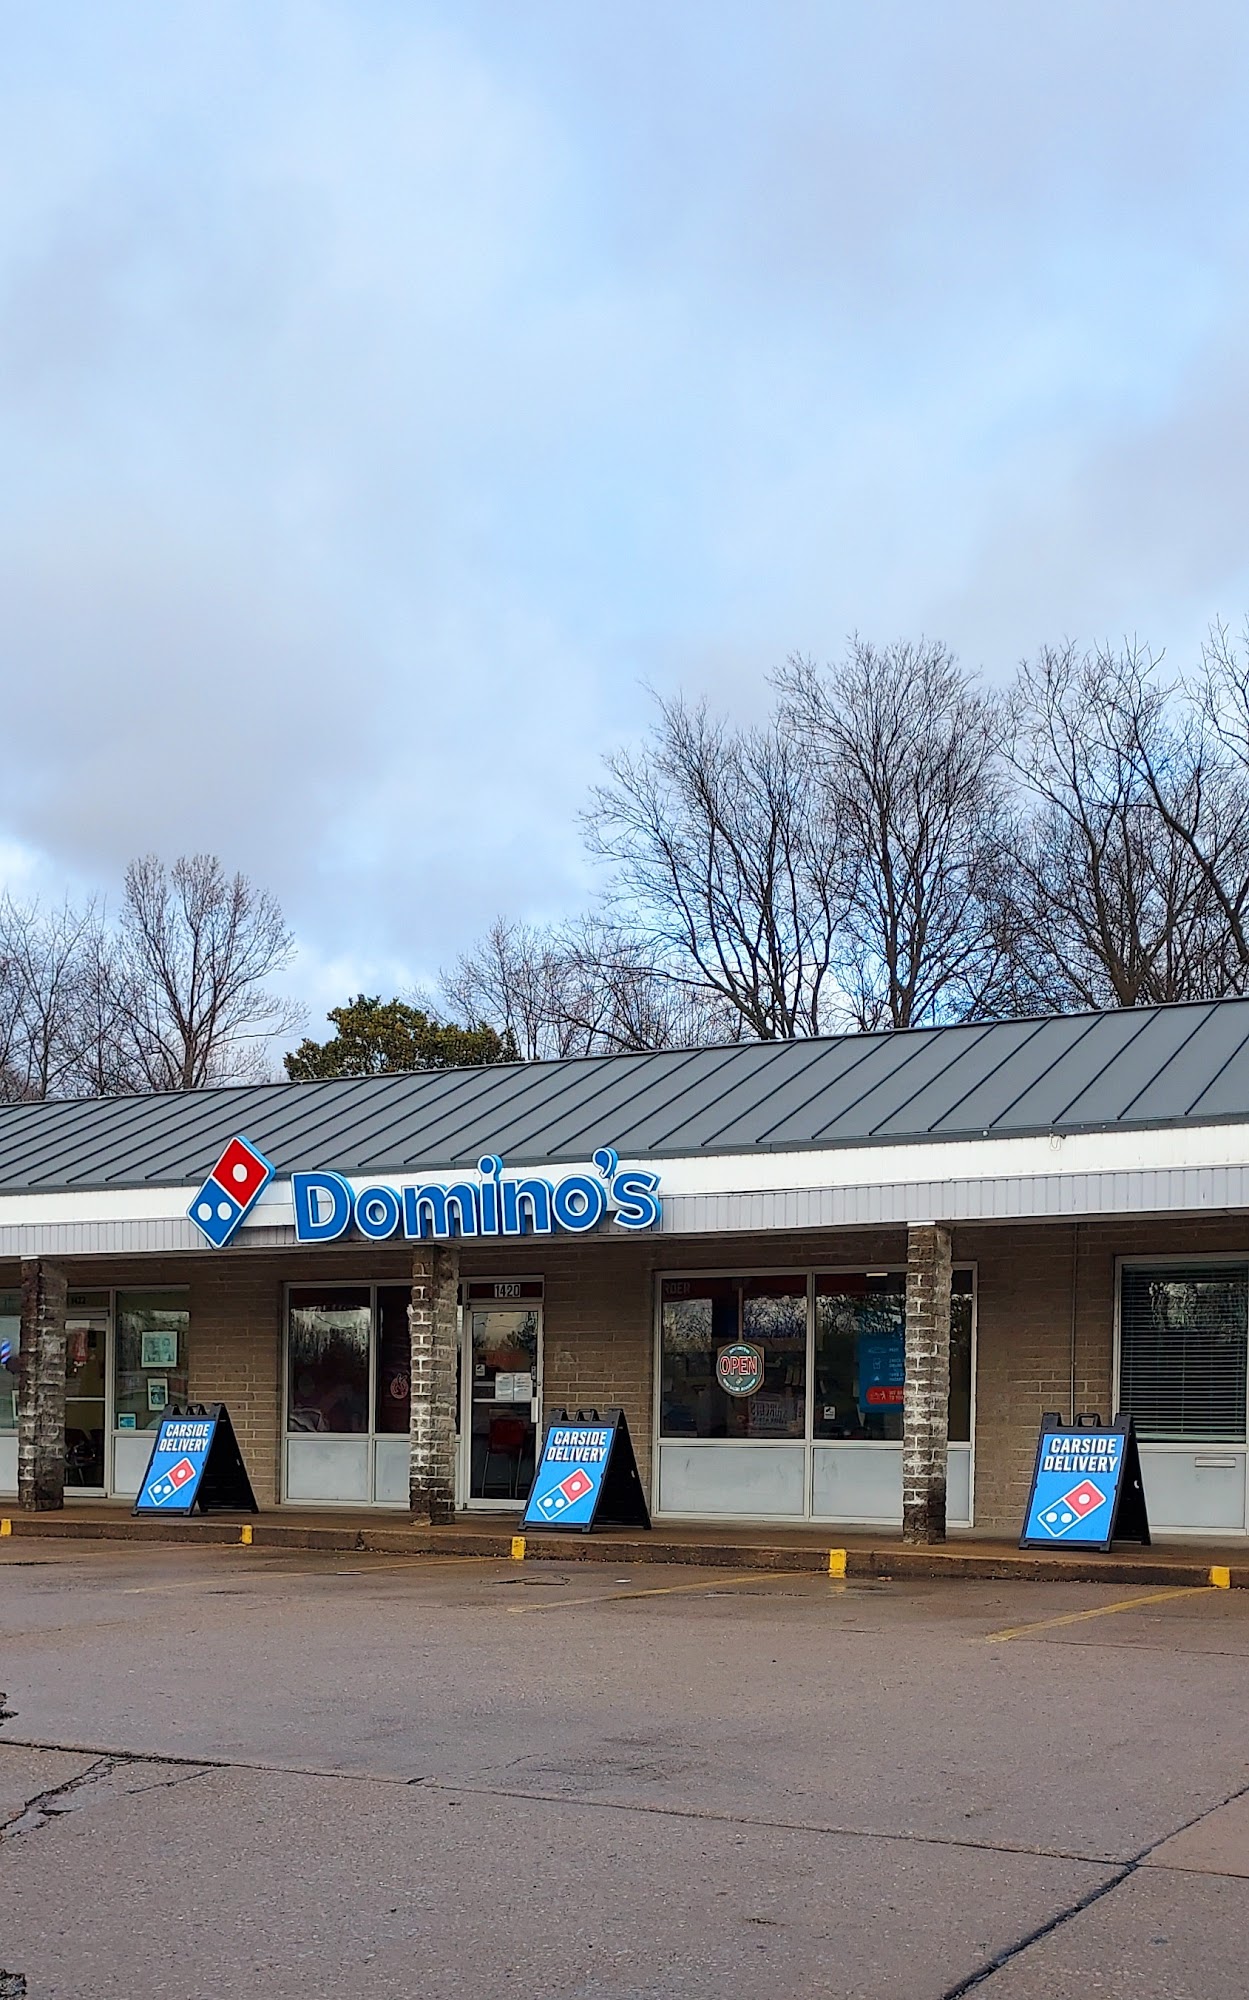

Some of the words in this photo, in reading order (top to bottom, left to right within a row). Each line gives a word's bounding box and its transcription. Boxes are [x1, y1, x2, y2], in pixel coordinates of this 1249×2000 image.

[292, 1147, 661, 1243] Domino's
[496, 1284, 519, 1297] 1420
[719, 1355, 758, 1376] OPEN
[165, 1424, 210, 1437] CARSIDE
[553, 1430, 608, 1446] CARSIDE
[158, 1438, 209, 1452] DELIVERY
[1050, 1437, 1117, 1454] CARSIDE
[545, 1446, 608, 1462] DELIVERY
[1043, 1455, 1119, 1473] DELIVERY
